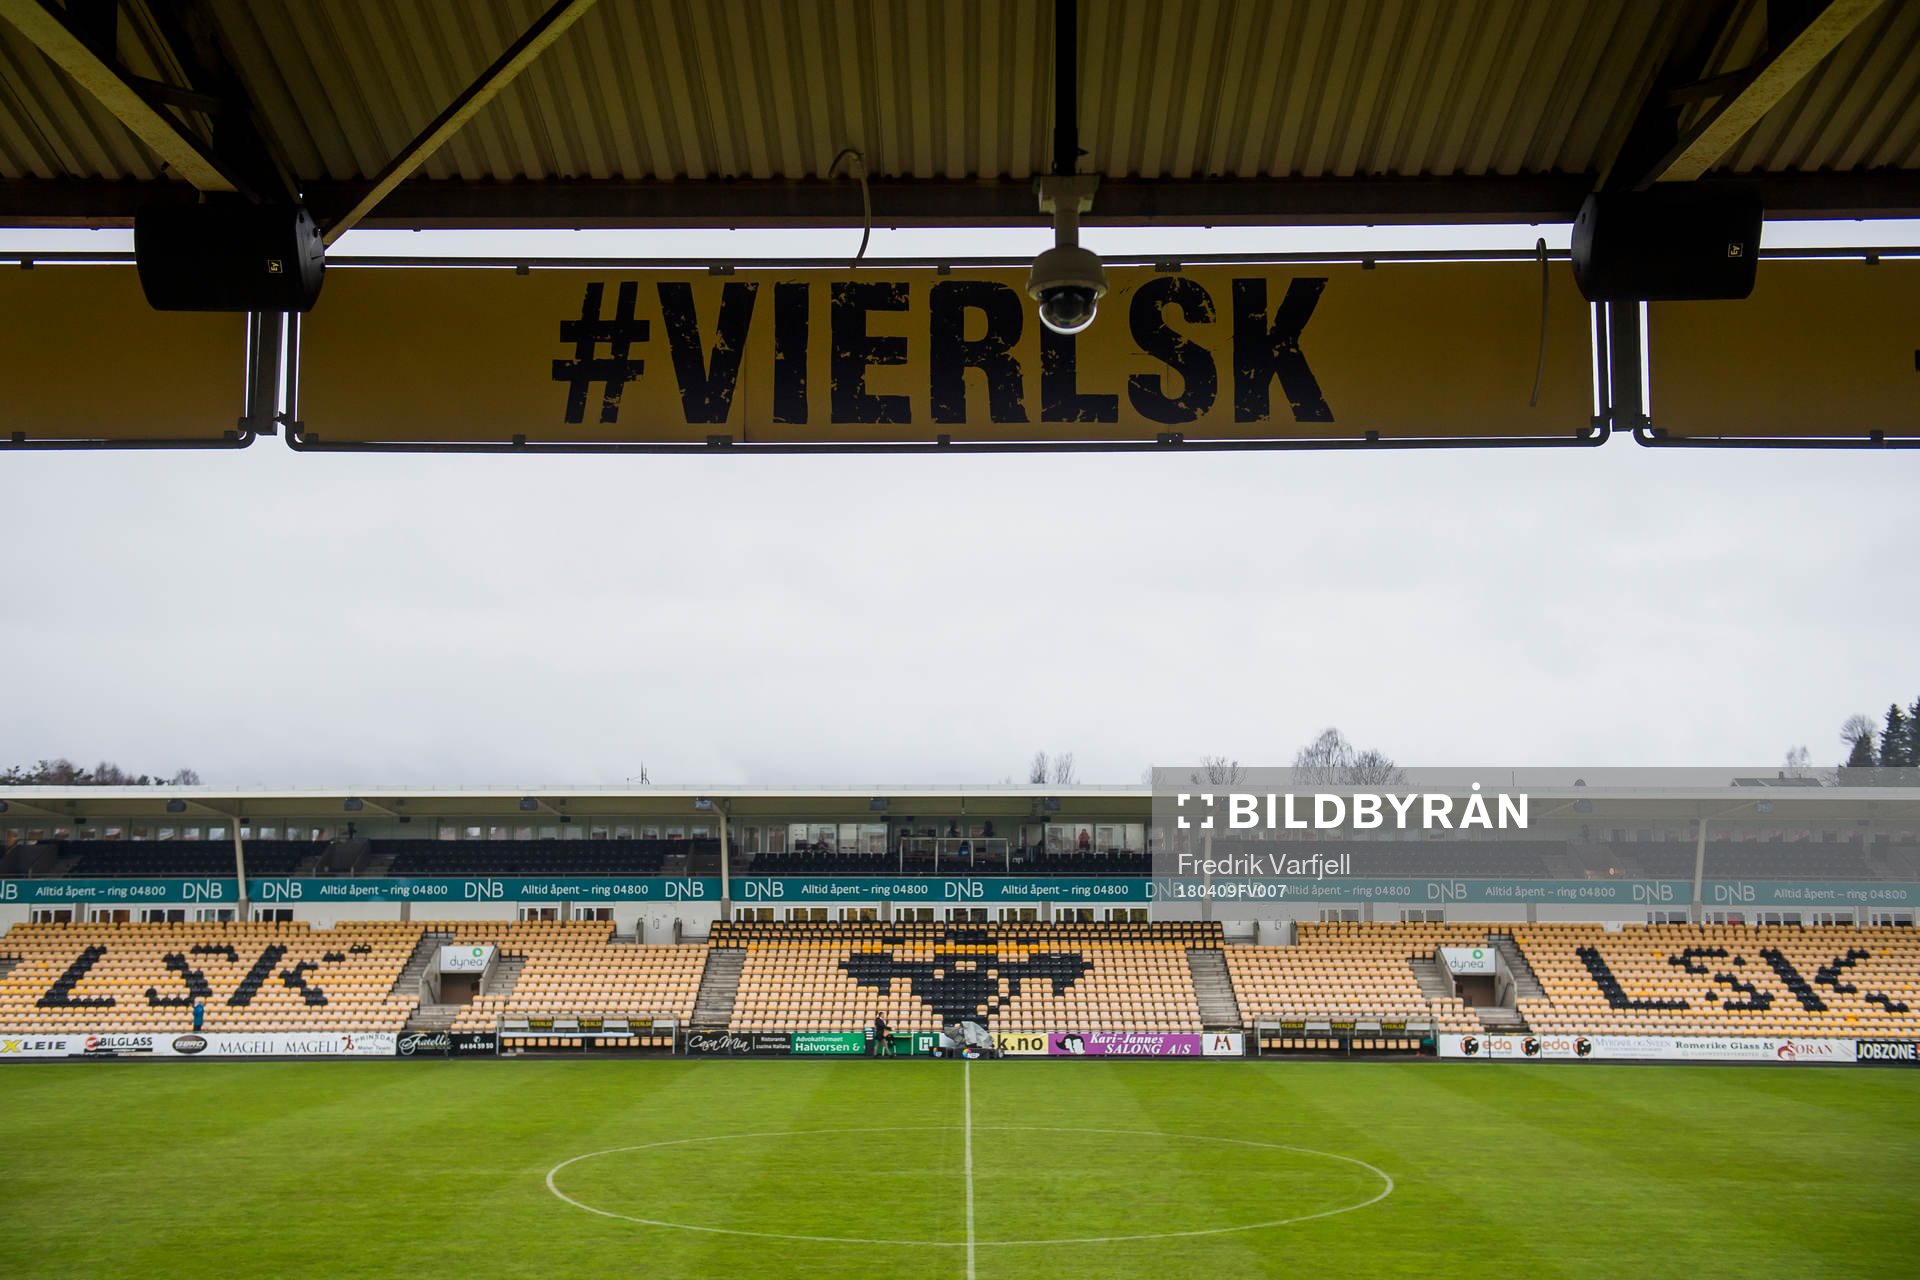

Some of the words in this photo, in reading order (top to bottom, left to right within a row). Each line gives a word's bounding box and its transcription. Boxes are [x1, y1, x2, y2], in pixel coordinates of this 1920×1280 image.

[551, 276, 1335, 425] #VIERLSK
[36, 886, 63, 896] Alltid
[66, 885, 96, 897] åpent
[108, 886, 127, 898] ring
[130, 886, 166, 896] 04800
[183, 879, 222, 902] DNB
[263, 878, 302, 902] DNB
[320, 885, 347, 895] Alltid
[350, 884, 379, 896] åpent
[391, 885, 409, 897] ring
[412, 885, 448, 895] 04800
[464, 878, 504, 901] DNB
[521, 885, 548, 895] Alltid
[550, 884, 580, 896] åpent
[592, 885, 611, 897] ring
[614, 885, 649, 895] 04800
[665, 878, 704, 901] DNB
[745, 878, 784, 901] DNB
[801, 885, 828, 895] Alltid
[830, 884, 860, 896] åpent
[871, 885, 890, 897] ring
[893, 885, 928, 895] 04800
[945, 878, 984, 901] DNB
[1001, 885, 1028, 895] Alltid
[1030, 884, 1060, 896] åpent
[1071, 885, 1091, 897] ring
[1093, 885, 1129, 895] 04800
[1311, 885, 1341, 897] åpent
[1353, 886, 1372, 898] ring
[1375, 886, 1411, 896] 04800
[1427, 879, 1467, 902] DNB
[1485, 887, 1512, 897] Alltid
[1514, 886, 1544, 898] åpent
[1557, 887, 1577, 899] ring
[1579, 887, 1616, 897] 04800
[1633, 881, 1673, 904] DNB
[1714, 881, 1755, 904] DNB
[1774, 889, 1801, 899] Alltid
[1804, 888, 1835, 900] åpent
[1847, 889, 1867, 901] ring
[1870, 889, 1907, 899] 04800
[450, 956, 483, 969] dynea
[1450, 957, 1484, 971] dynea
[100, 1037, 153, 1047] BILGLASS
[1090, 1034, 1164, 1044] Kari-Jannes
[1675, 1041, 1727, 1050] Romerike
[1730, 1042, 1760, 1050] Glass
[795, 1043, 850, 1051] Halvorsen
[852, 1043, 860, 1051] &
[1105, 1044, 1162, 1055] SALONG
[1167, 1044, 1191, 1055] A/S
[1857, 1043, 1916, 1059] JOBZONE
